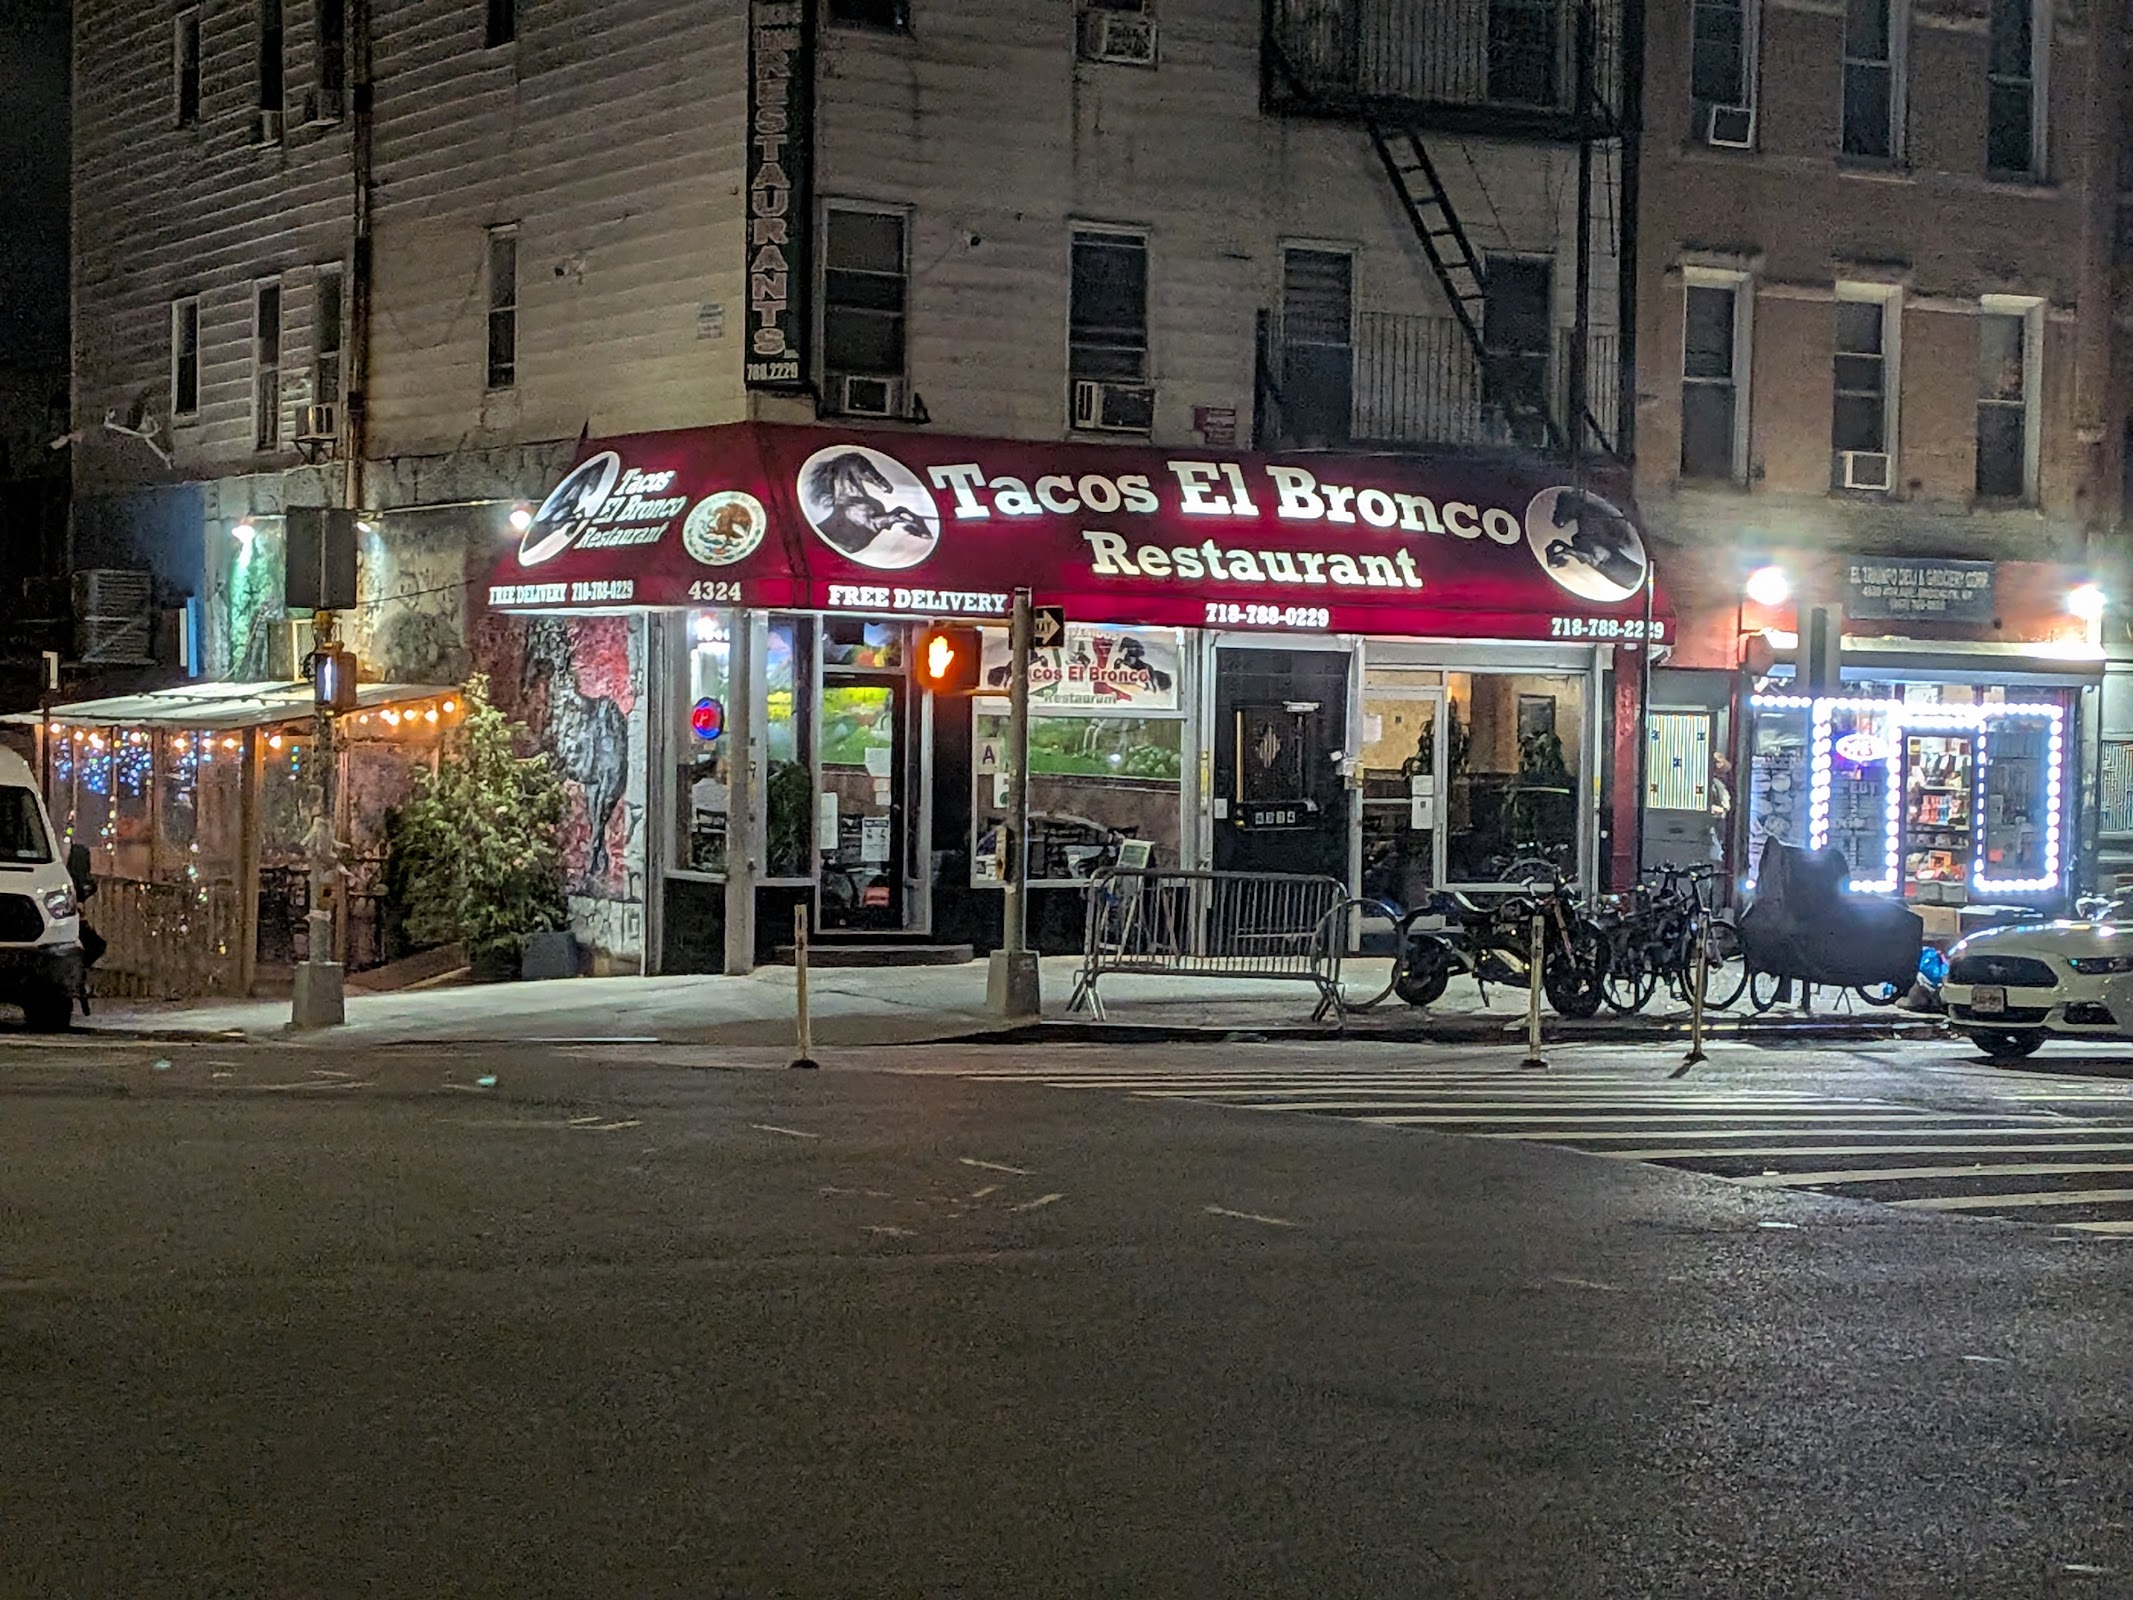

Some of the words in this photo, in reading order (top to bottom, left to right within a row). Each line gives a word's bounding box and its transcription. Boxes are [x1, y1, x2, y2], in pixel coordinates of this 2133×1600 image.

[614, 467, 677, 496] Tacos
[592, 496, 627, 525] El
[615, 494, 687, 522] Bronco
[927, 463, 1159, 520] Tacos
[1167, 460, 1260, 517] El
[1266, 464, 1522, 545] Bronco
[573, 520, 670, 549] Restaurant
[1082, 530, 1423, 588] Restaurant
[488, 585, 515, 605] FREE
[516, 583, 567, 603] DELIVERY
[687, 580, 742, 602] 4324
[828, 584, 889, 606] FREE
[893, 587, 1009, 613] DELIVERY
[1205, 602, 1330, 628] 718-788-0229
[1031, 666, 1062, 682] cos
[1068, 665, 1084, 682] El
[1089, 667, 1149, 683] Bronco
